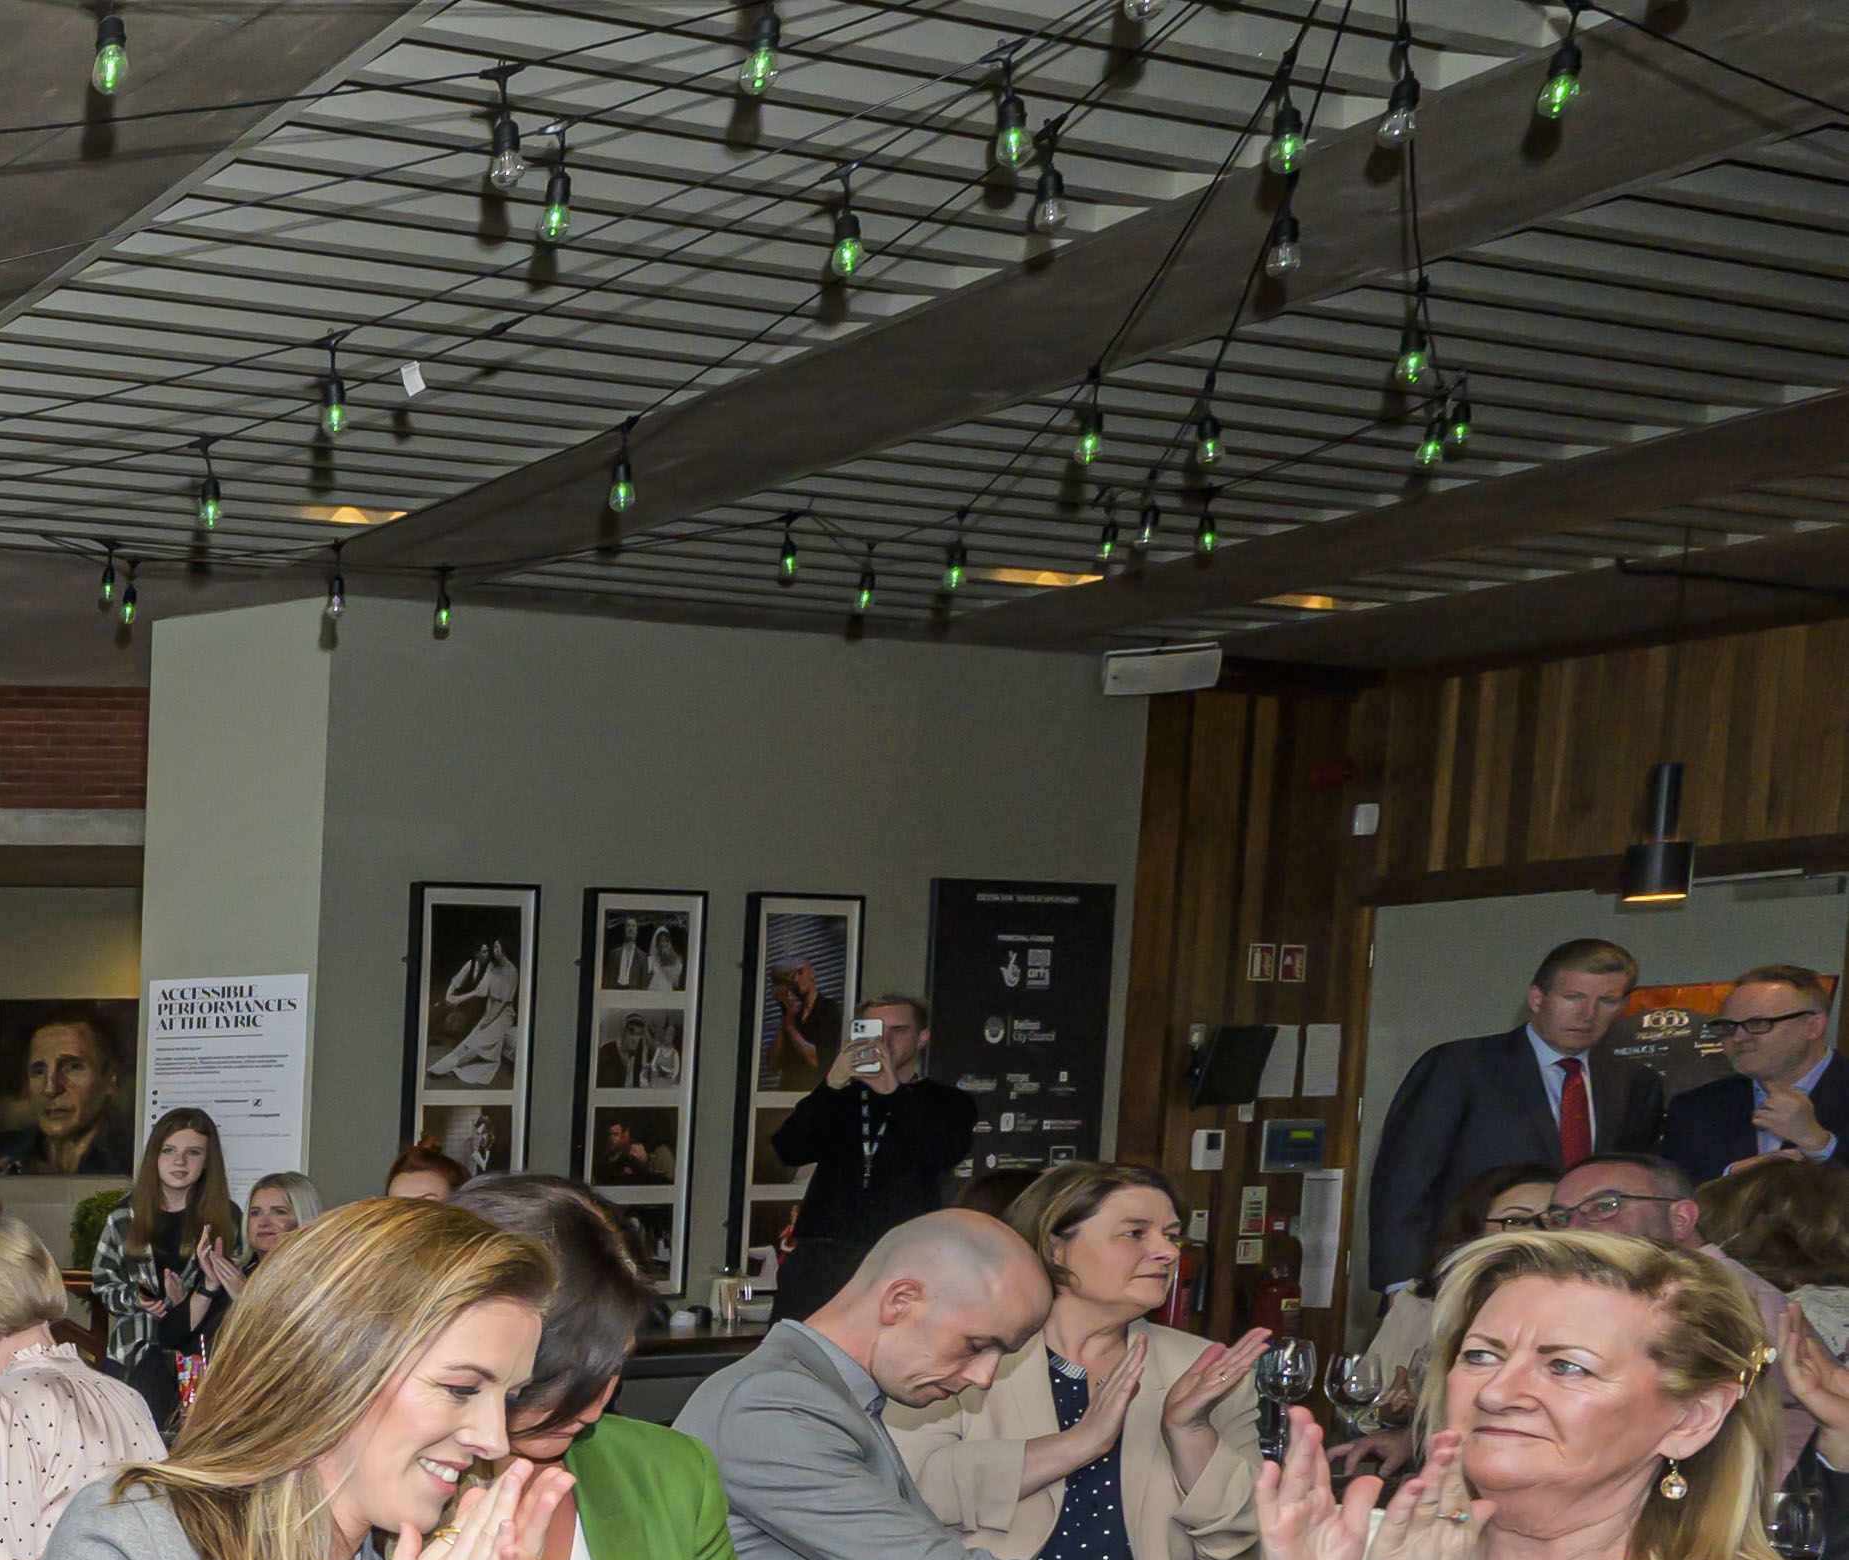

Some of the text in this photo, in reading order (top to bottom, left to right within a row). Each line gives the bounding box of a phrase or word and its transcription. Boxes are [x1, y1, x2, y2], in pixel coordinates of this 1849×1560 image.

[157, 984, 258, 1001] ACCESSIBLE
[157, 998, 297, 1016] PERFORMANCES
[156, 1014, 264, 1031] AT THE LYRIC
